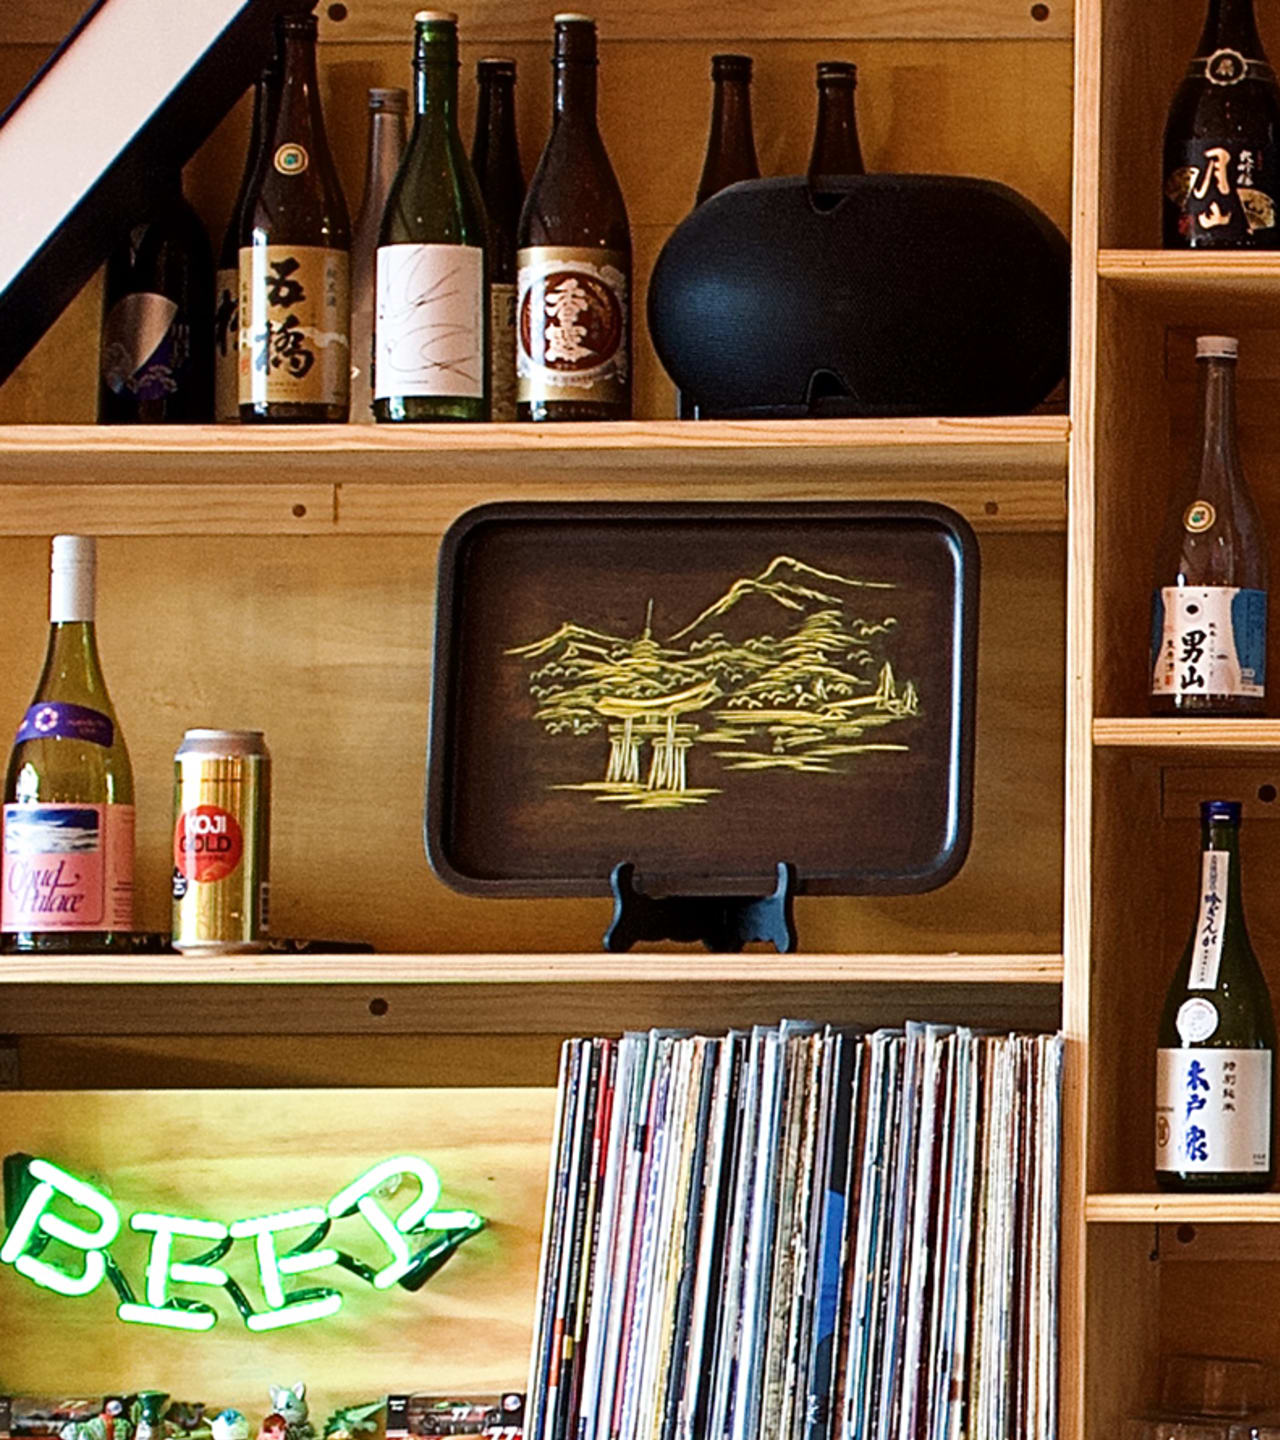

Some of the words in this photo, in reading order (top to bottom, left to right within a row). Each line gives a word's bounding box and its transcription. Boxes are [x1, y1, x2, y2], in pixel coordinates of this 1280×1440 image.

[1193, 147, 1232, 230] 月山
[1178, 629, 1208, 690] 男山
[178, 835, 232, 854] GOLD
[184, 814, 227, 835] KOJI
[18, 887, 86, 914] Palace
[1, 1153, 482, 1331] BEER
